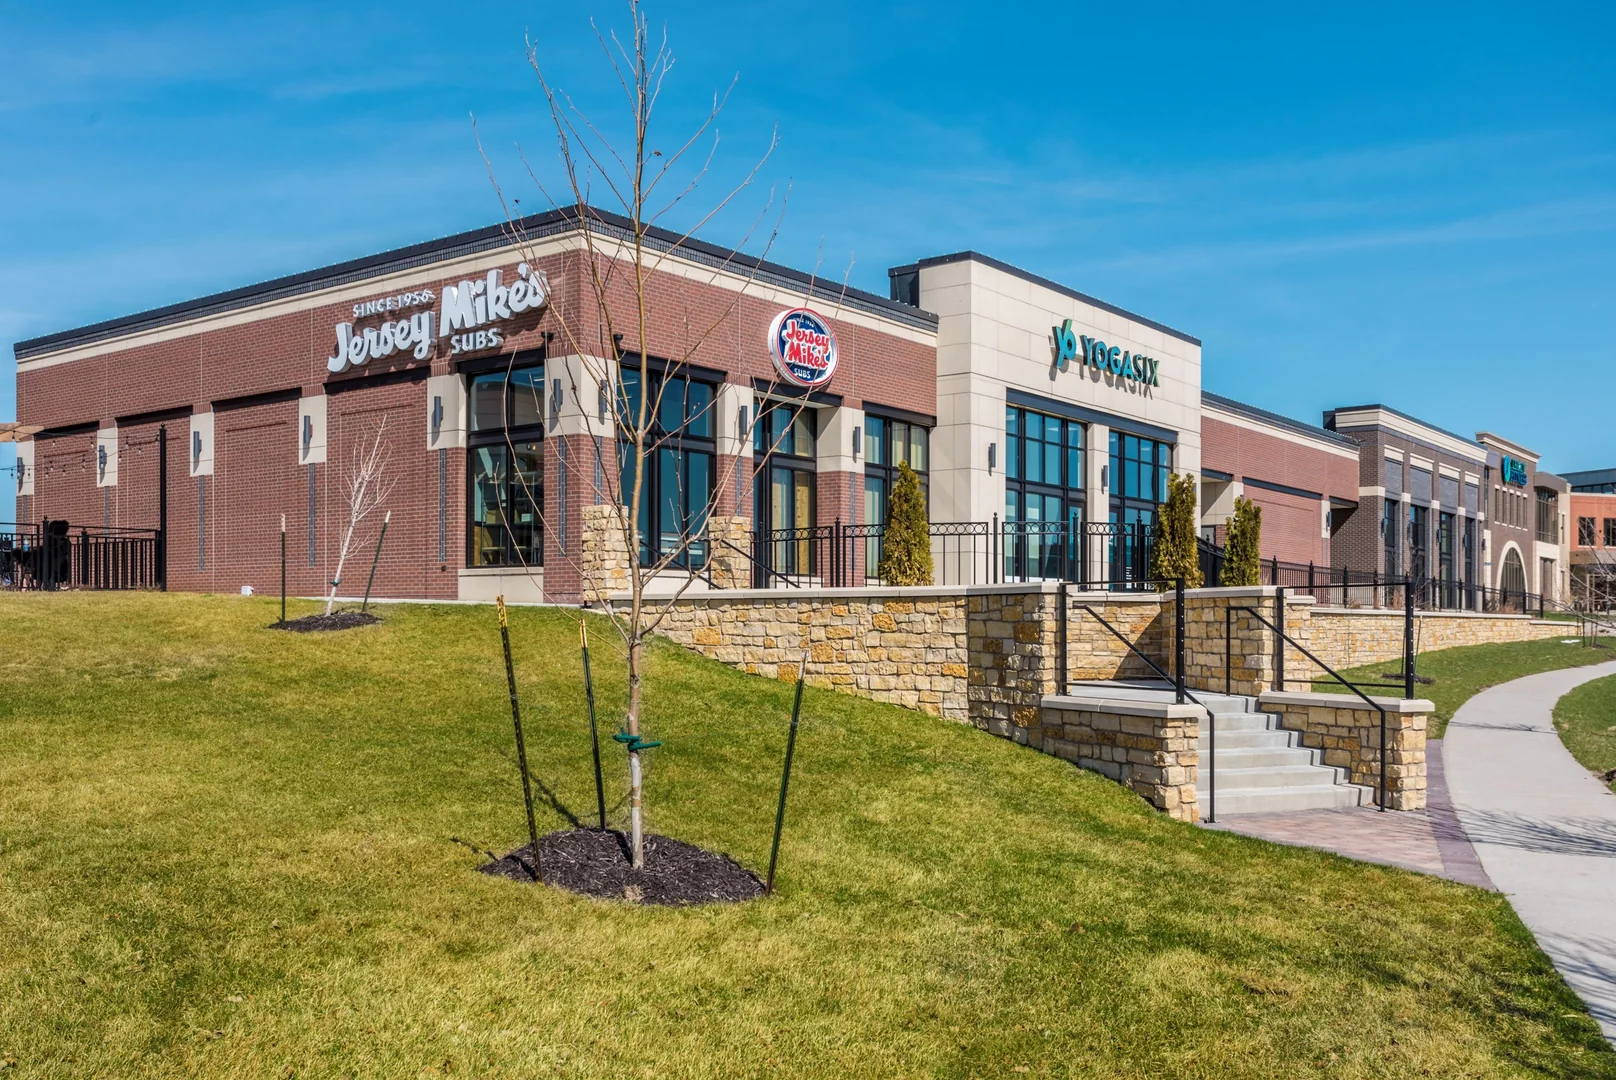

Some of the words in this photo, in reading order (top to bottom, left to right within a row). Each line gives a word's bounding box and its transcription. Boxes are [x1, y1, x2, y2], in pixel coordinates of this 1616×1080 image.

[327, 311, 434, 373] Jersey
[440, 263, 548, 338] Mike's
[353, 297, 395, 318] SINCE
[398, 289, 433, 309] 1956
[451, 328, 502, 354] SUBS
[786, 320, 830, 355] Jersey
[788, 341, 829, 369] Mike's
[1080, 335, 1160, 388] YOGASIX
[793, 368, 811, 379] SUBS
